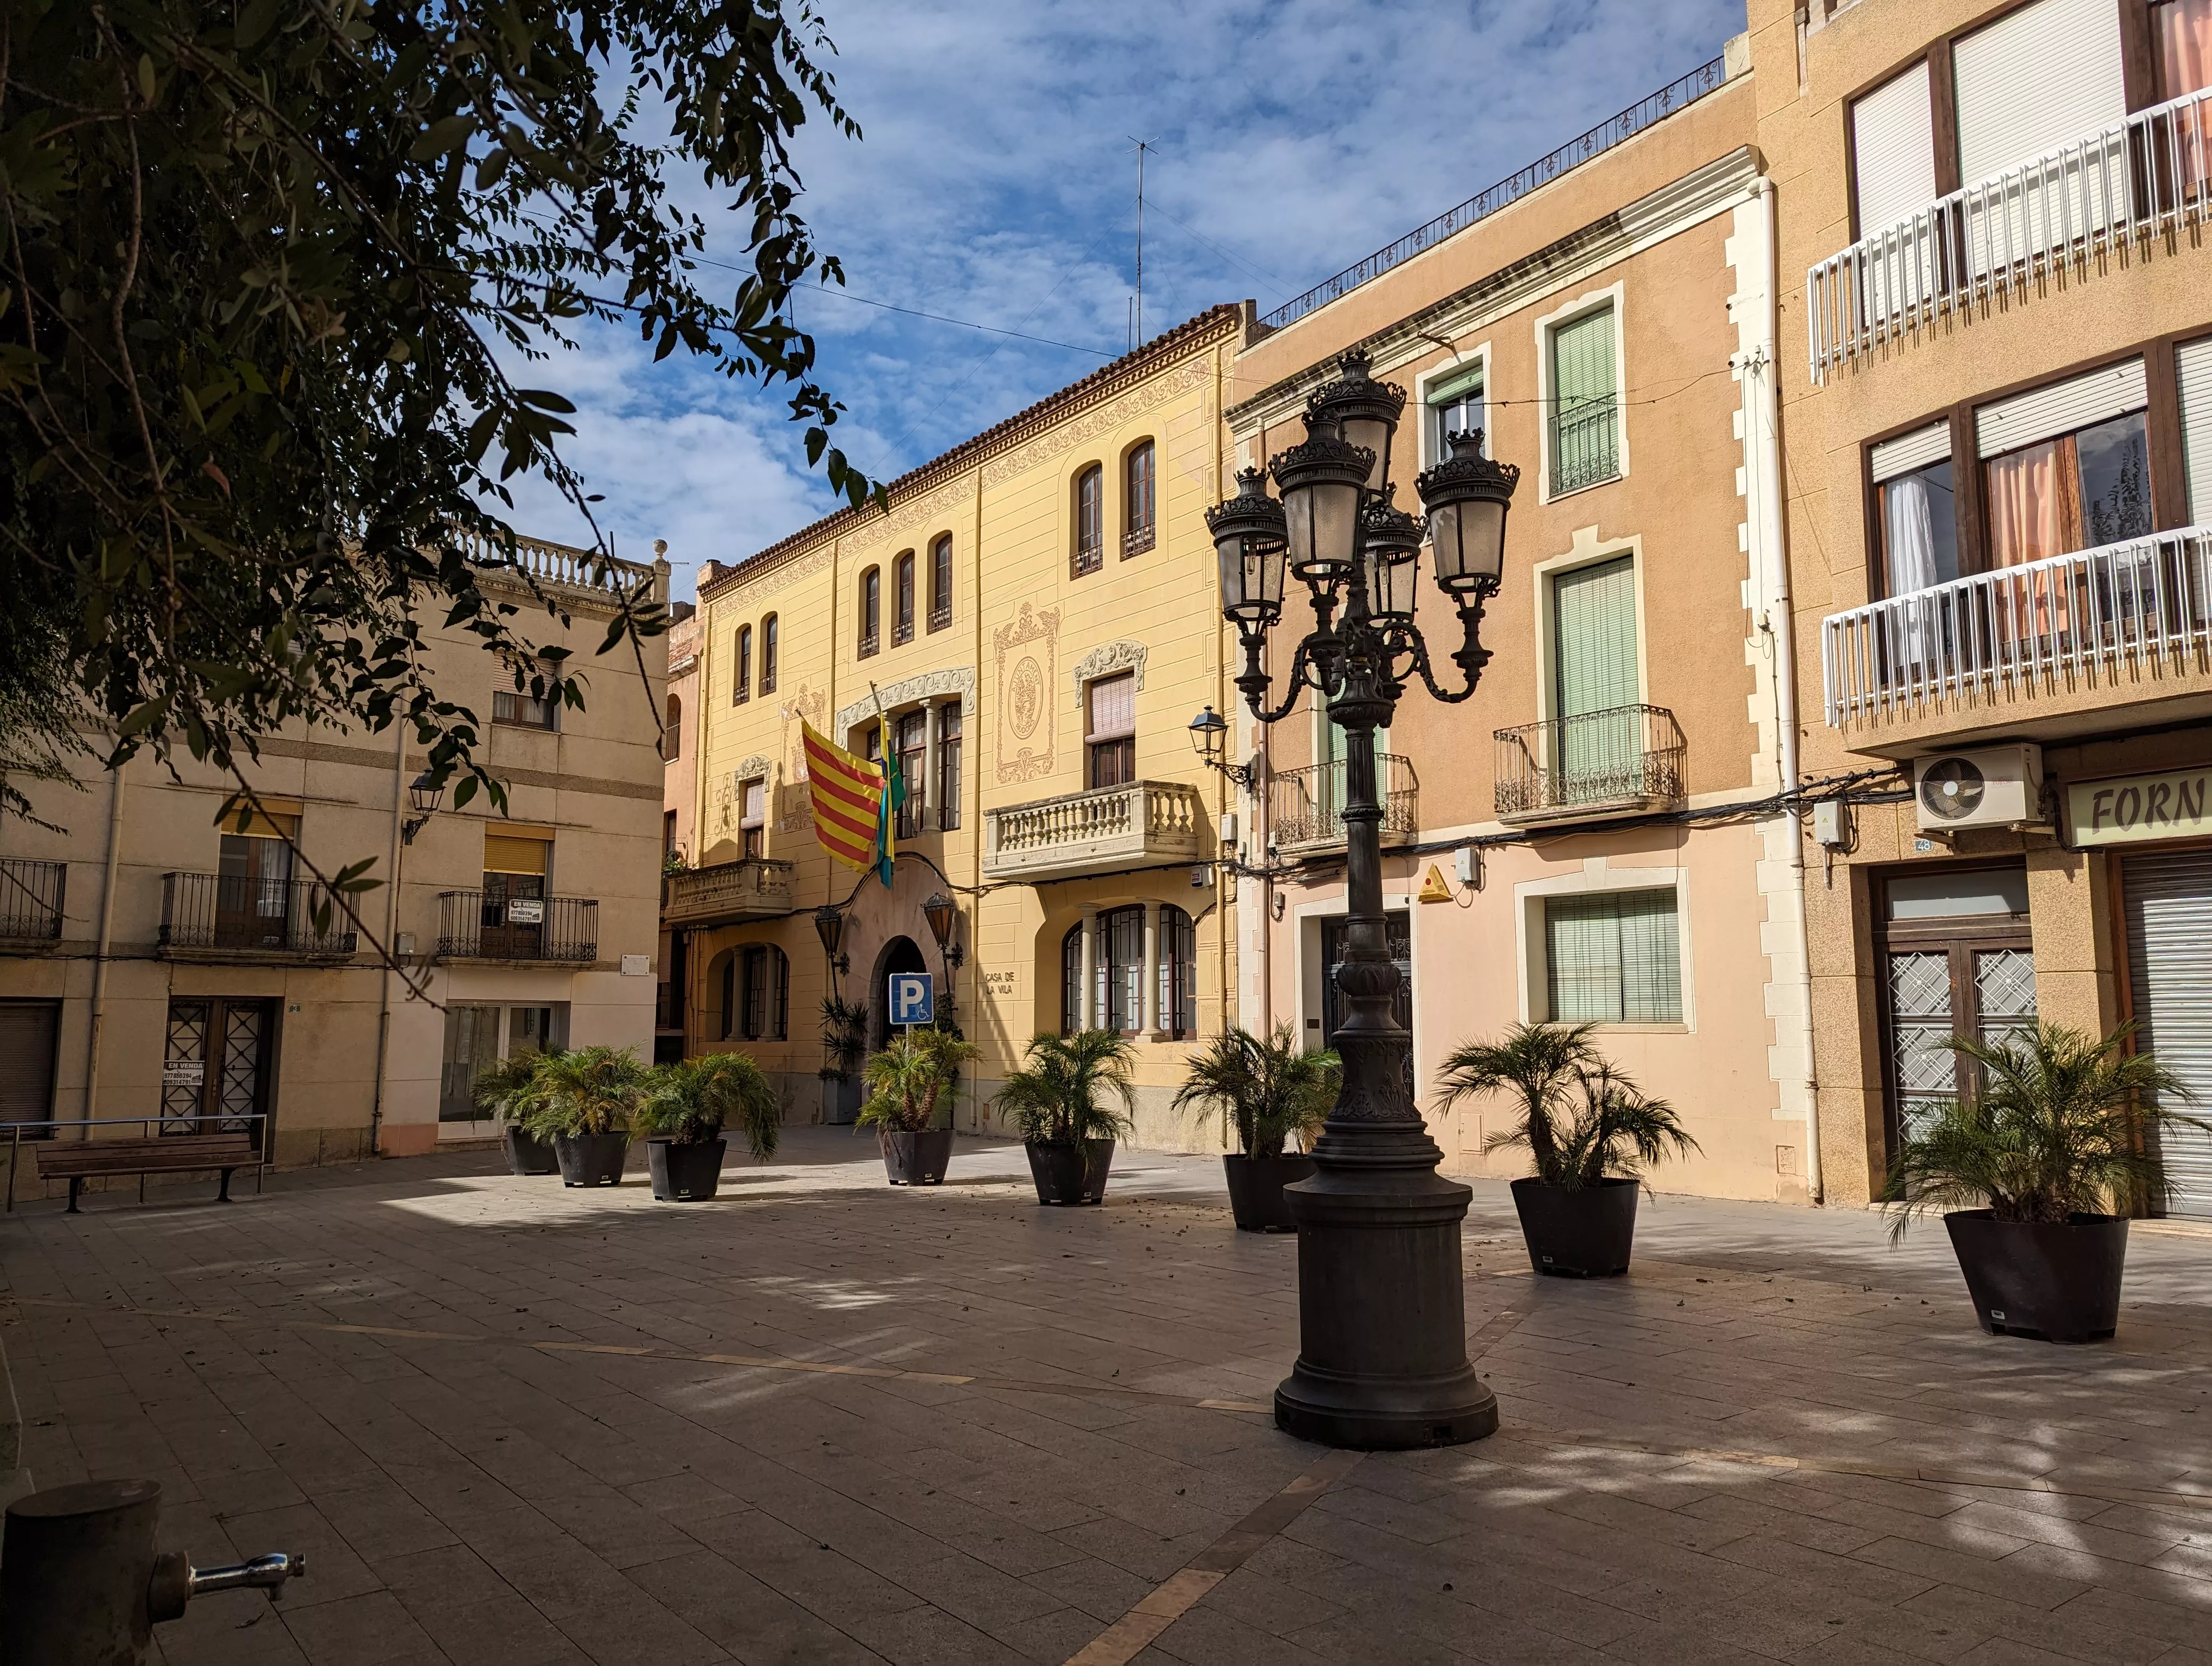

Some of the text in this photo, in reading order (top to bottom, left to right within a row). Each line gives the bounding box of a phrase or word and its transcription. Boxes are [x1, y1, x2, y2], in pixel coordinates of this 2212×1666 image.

[1012, 662, 1040, 693] AJUNTAMENT
[2092, 778, 2205, 835] FORN
[1918, 840, 1930, 850] 48
[985, 971, 1015, 982] CASA DE
[900, 979, 924, 1018] P
[986, 984, 1013, 995] LA VILA
